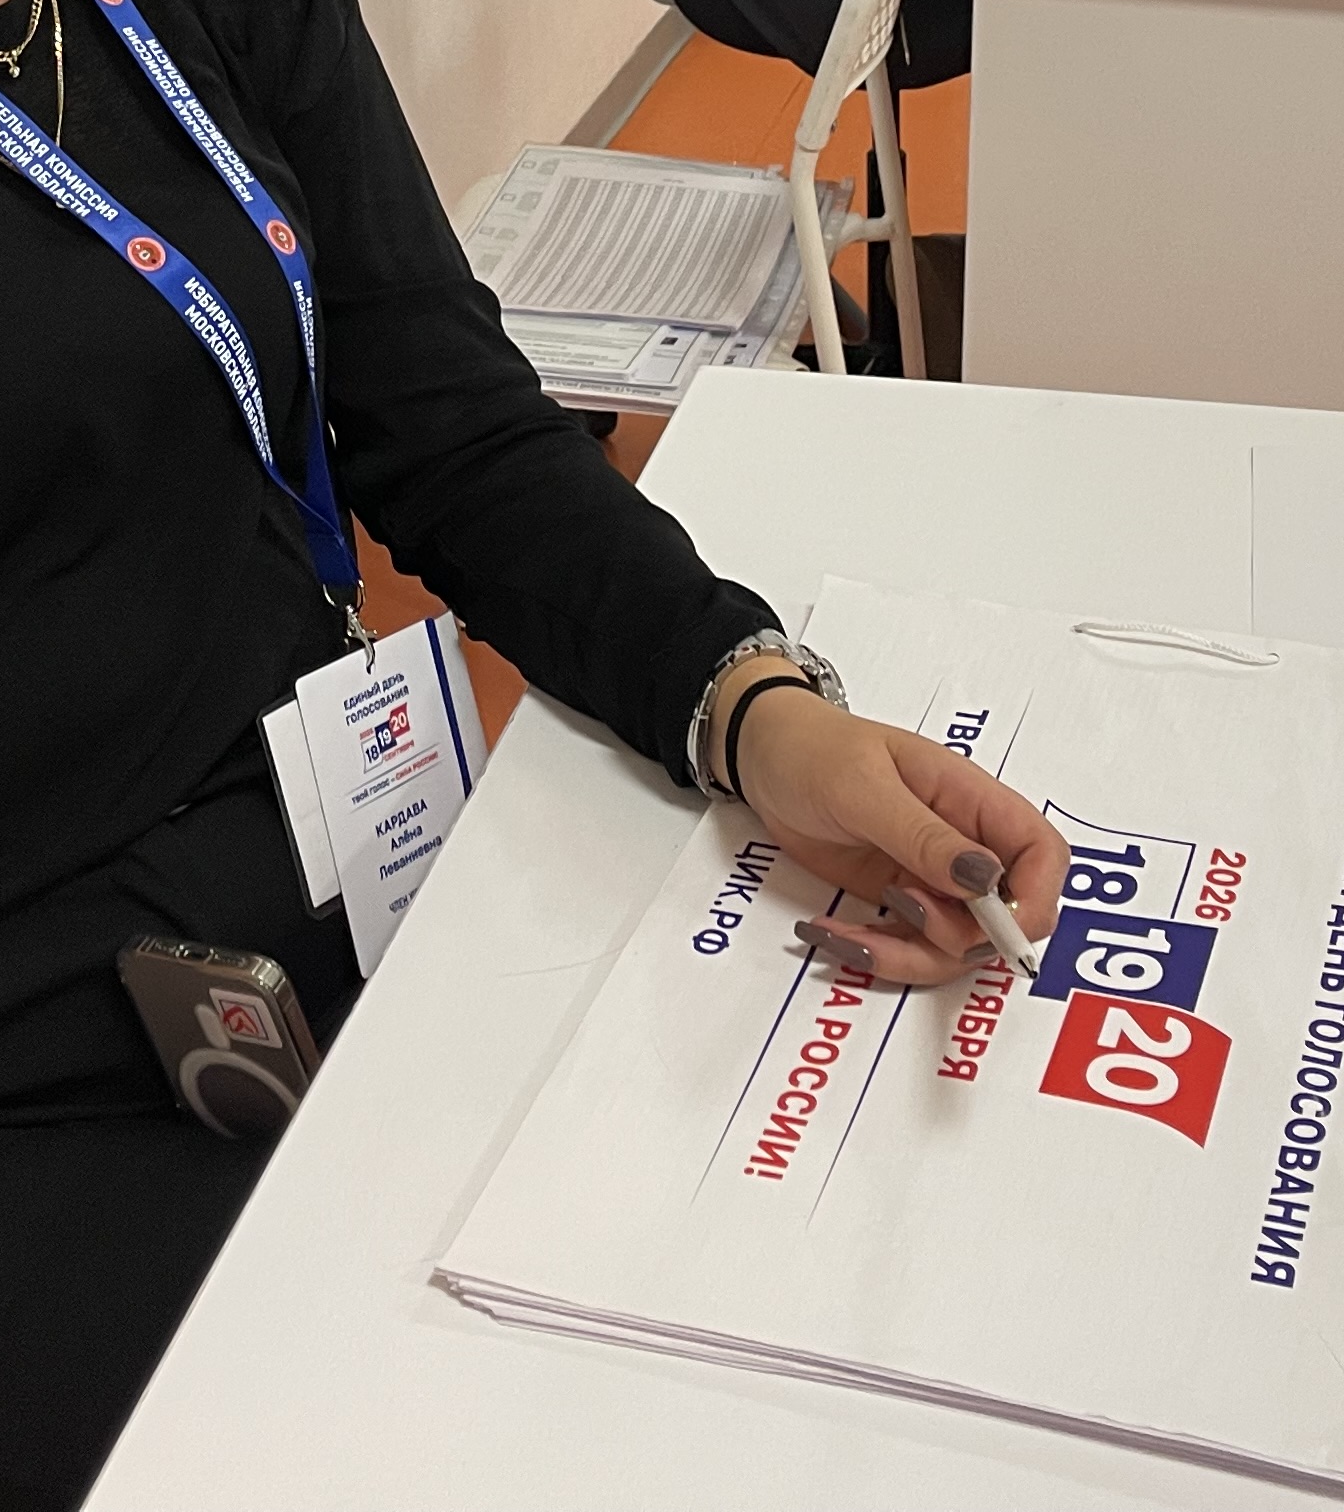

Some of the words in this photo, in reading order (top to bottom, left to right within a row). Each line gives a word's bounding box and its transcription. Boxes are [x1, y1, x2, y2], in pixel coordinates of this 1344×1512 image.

[122, 26, 178, 98] КОМИССИЯ
[145, 38, 191, 97] ОБЛАСТИ
[172, 99, 254, 203] ИЗБИРАТЕЛЬНАЯ
[184, 98, 255, 184] МОСКОВСКОЙ
[29, 163, 91, 218] ОБЛАСТИ
[45, 153, 119, 221] КОМИССИЯ
[184, 276, 257, 392] ИЗБИРАТЕЛЬНАЯ
[184, 304, 250, 401] МОСКОВСКОЙ
[343, 681, 381, 711] ЕДИНЫЙ
[382, 673, 405, 693] ДЕНЬ
[345, 685, 410, 726] ГОЛОСОВАНИЯ
[365, 745, 380, 763] 18
[378, 729, 392, 747] 19
[390, 712, 407, 732] 20
[375, 798, 428, 839] КАРДАВА
[691, 840, 782, 956] ЦИК.РФ
[1061, 842, 1147, 906] 18
[1194, 848, 1247, 923] 2026
[822, 962, 875, 1008] ЛА
[1074, 927, 1172, 992] 19
[1084, 1006, 1193, 1107] 20
[742, 1016, 853, 1181] РОССИИ!
